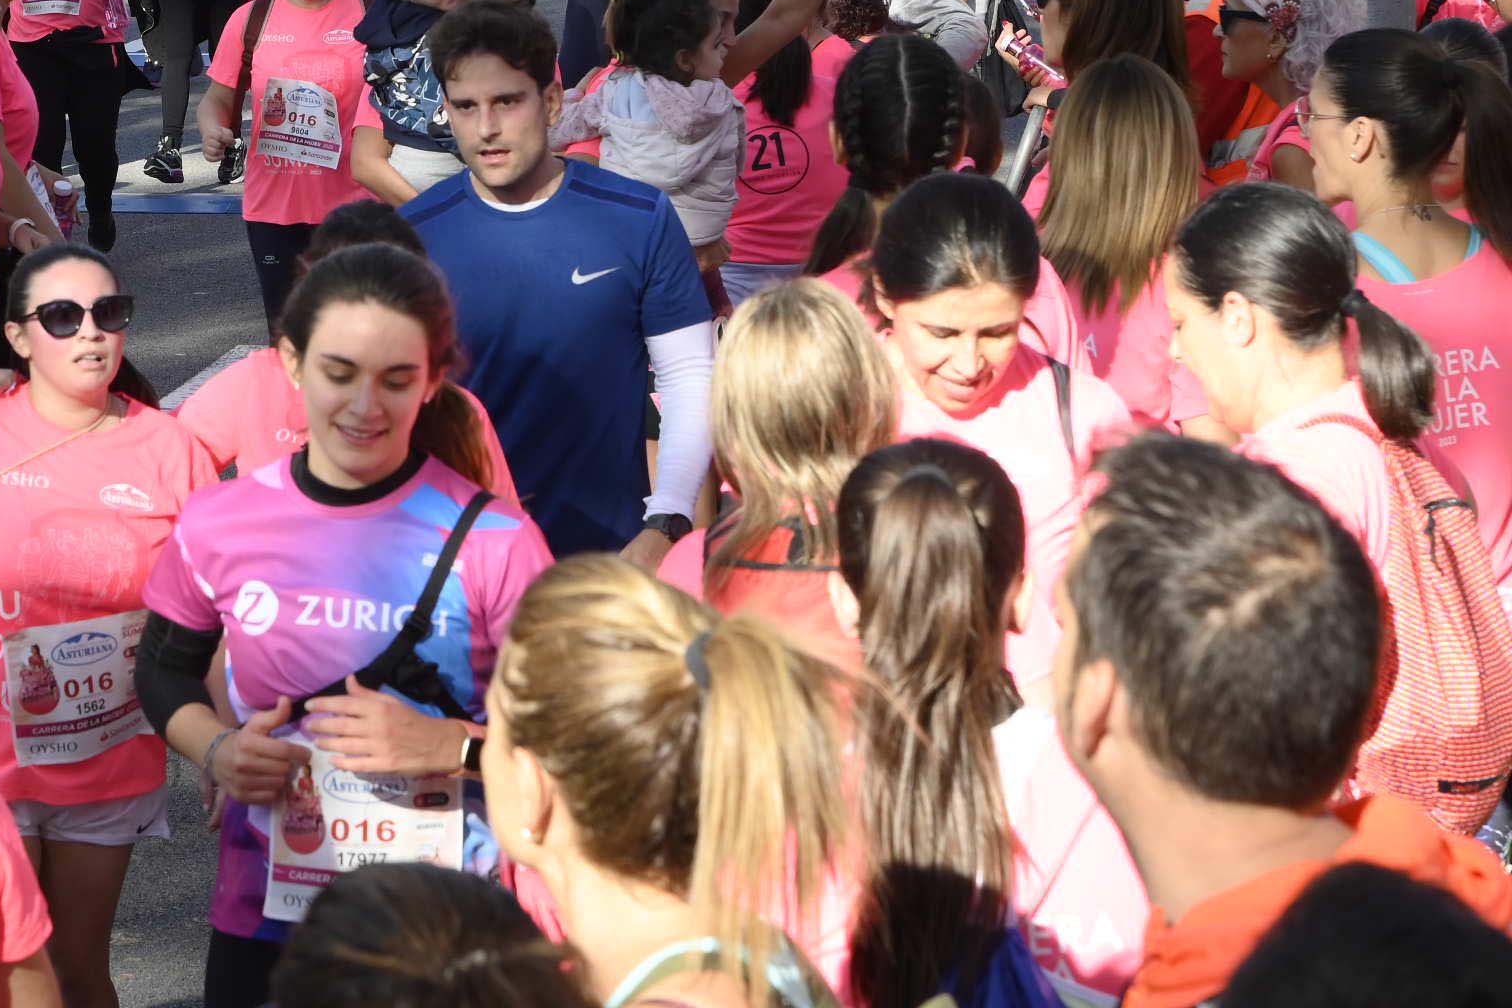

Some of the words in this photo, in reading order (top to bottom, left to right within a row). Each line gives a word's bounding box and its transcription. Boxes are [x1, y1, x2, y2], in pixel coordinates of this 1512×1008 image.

[288, 111, 317, 126] 016
[748, 131, 786, 171] 21
[1444, 376, 1481, 403] LA
[1426, 402, 1492, 435] UJER
[56, 642, 114, 662] ASTURIANA
[63, 671, 114, 699] 016
[75, 698, 106, 716] 1562
[31, 720, 75, 735] CARRERA
[76, 719, 88, 731] DE
[88, 716, 101, 728] LA
[29, 741, 79, 755] OYSHO
[328, 775, 408, 795] ASTURIANA
[330, 817, 397, 843] 016
[336, 851, 388, 867] 17977
